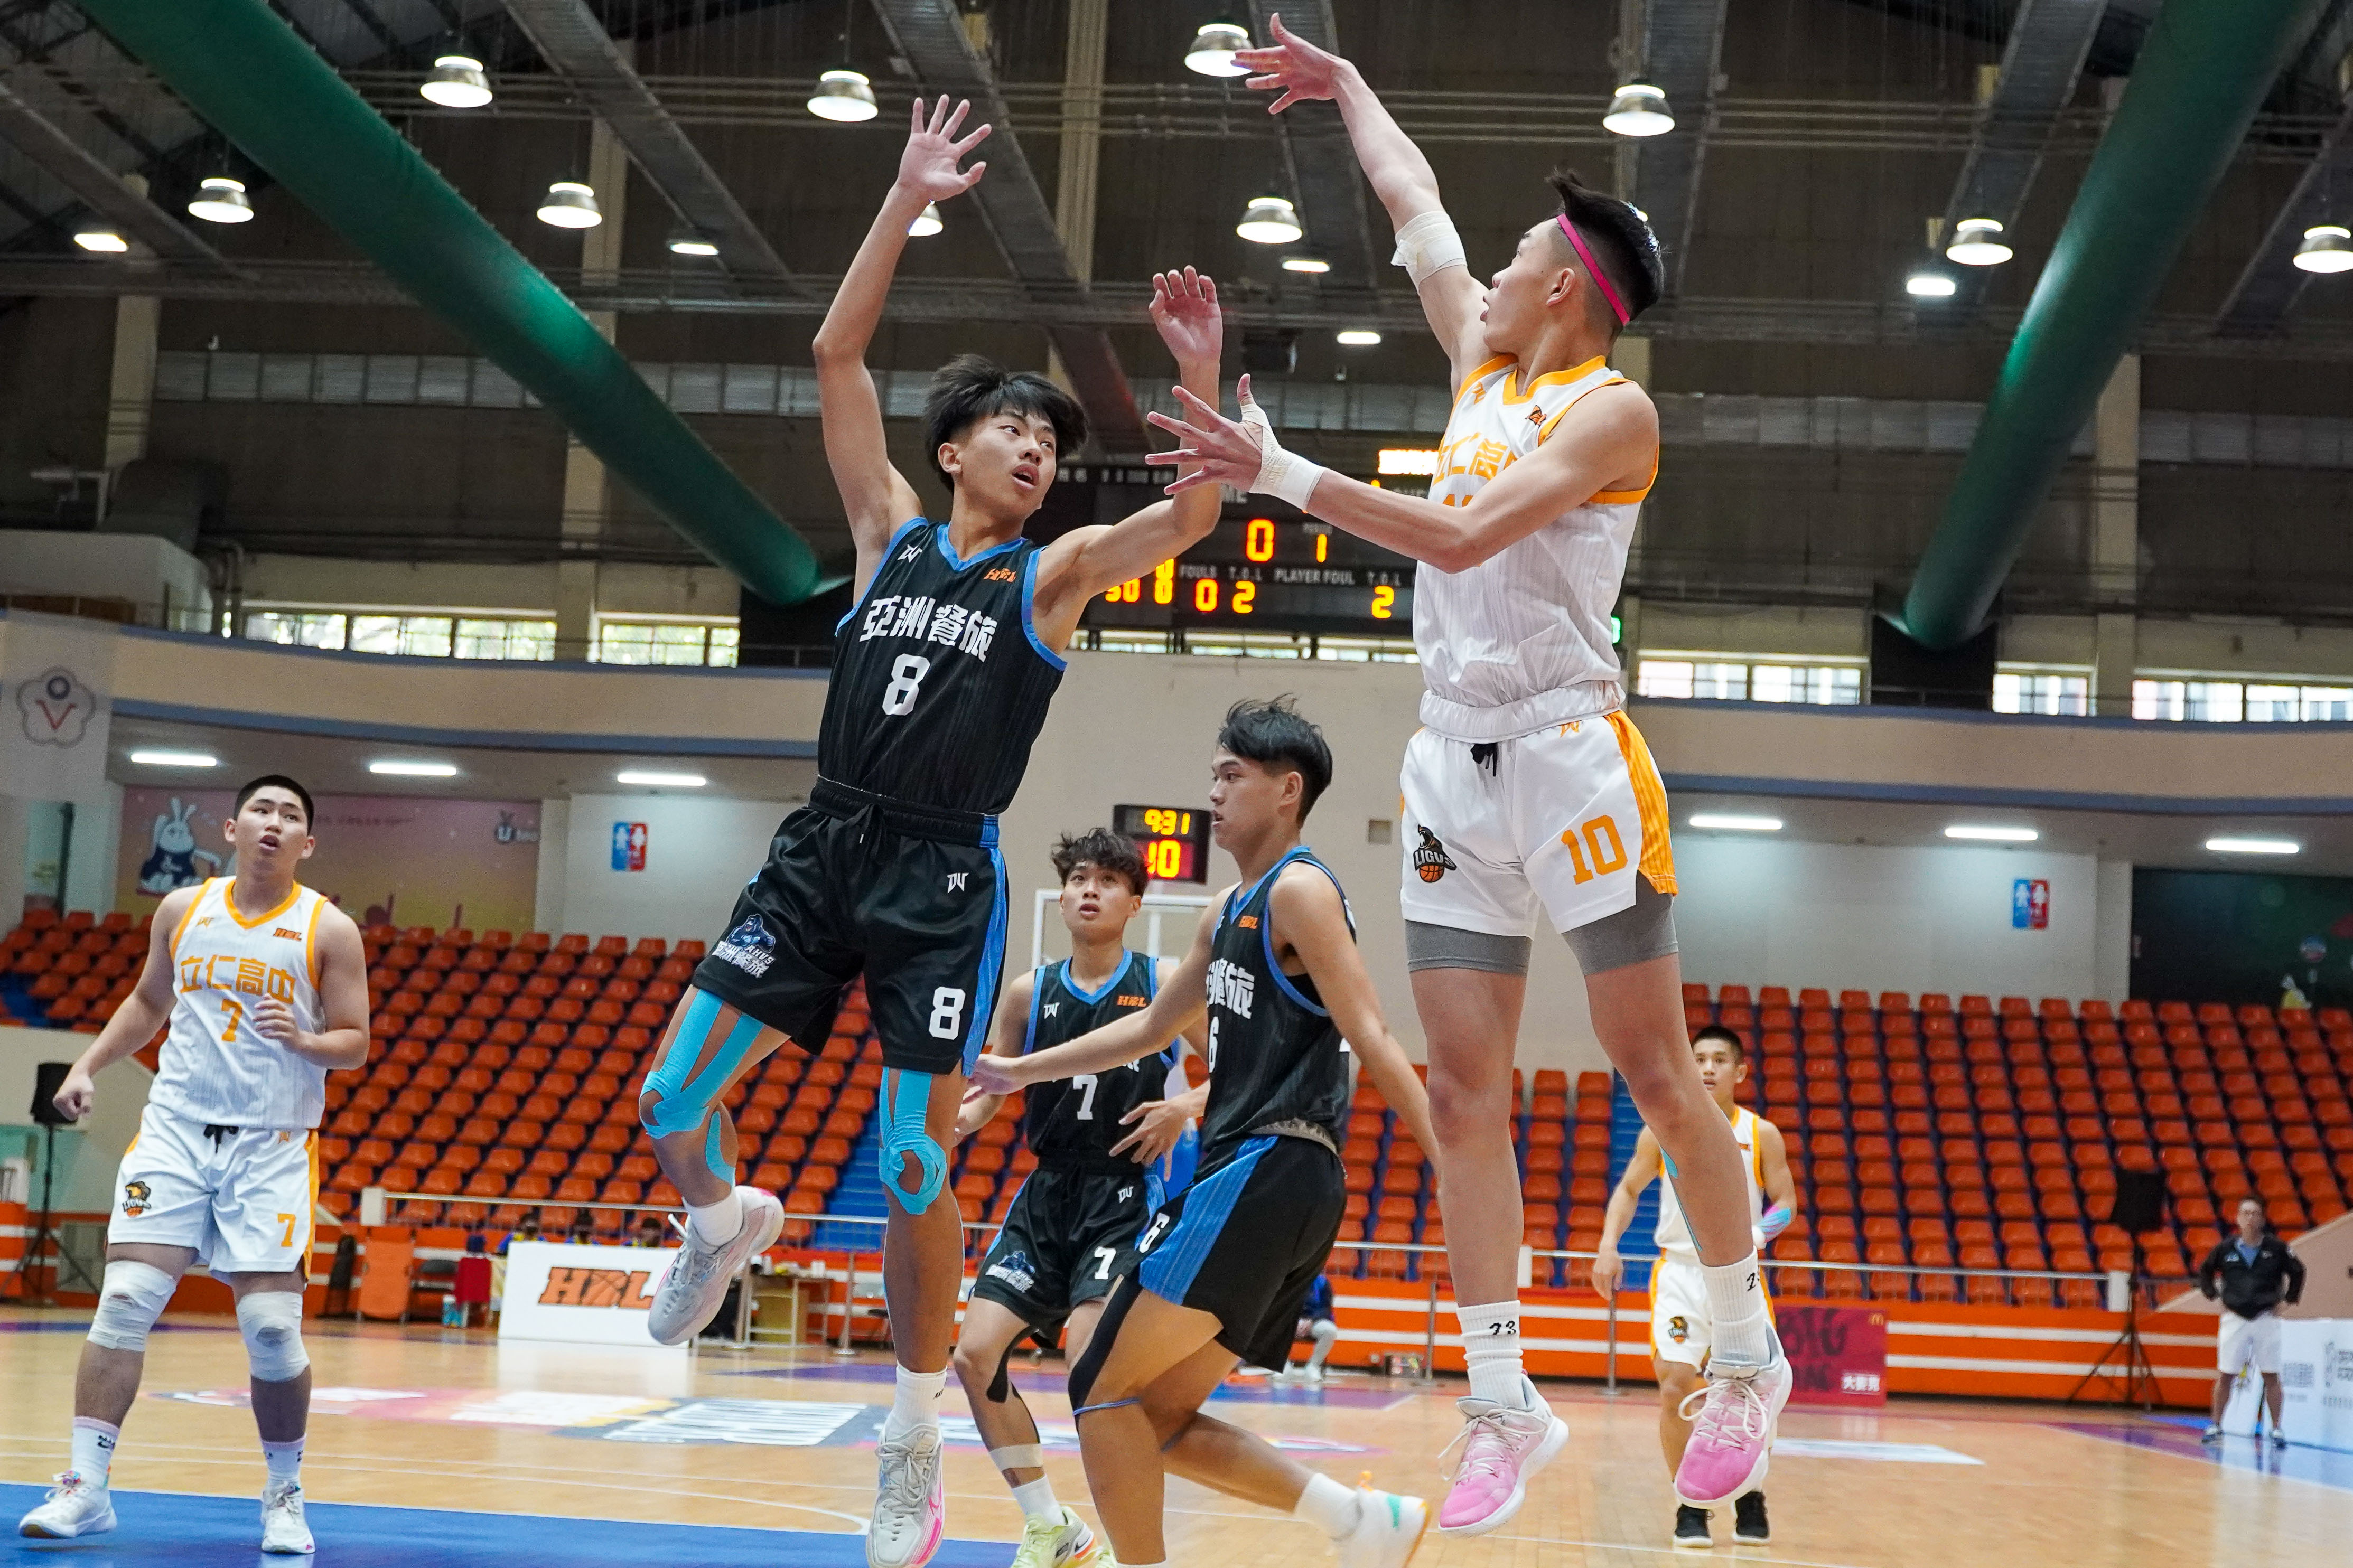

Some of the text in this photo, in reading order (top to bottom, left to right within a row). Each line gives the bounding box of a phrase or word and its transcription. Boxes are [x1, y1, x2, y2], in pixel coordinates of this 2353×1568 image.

[1246, 519, 1274, 561] 0
[1316, 534, 1327, 562] 1
[1195, 579, 1218, 612] 0
[1232, 580, 1255, 613] 2
[1371, 585, 1394, 618] 2
[859, 595, 998, 663] 亞洲餐旅
[882, 653, 930, 715] 8
[1561, 815, 1628, 885] 10
[180, 954, 296, 1004] 立仁高中
[221, 998, 242, 1042] 7
[929, 987, 966, 1040] 8
[1208, 1016, 1219, 1073] 6
[1073, 1075, 1098, 1120] 7
[277, 1213, 296, 1247] 7
[1139, 1213, 1170, 1253] 6
[1094, 1246, 1116, 1279] 7
